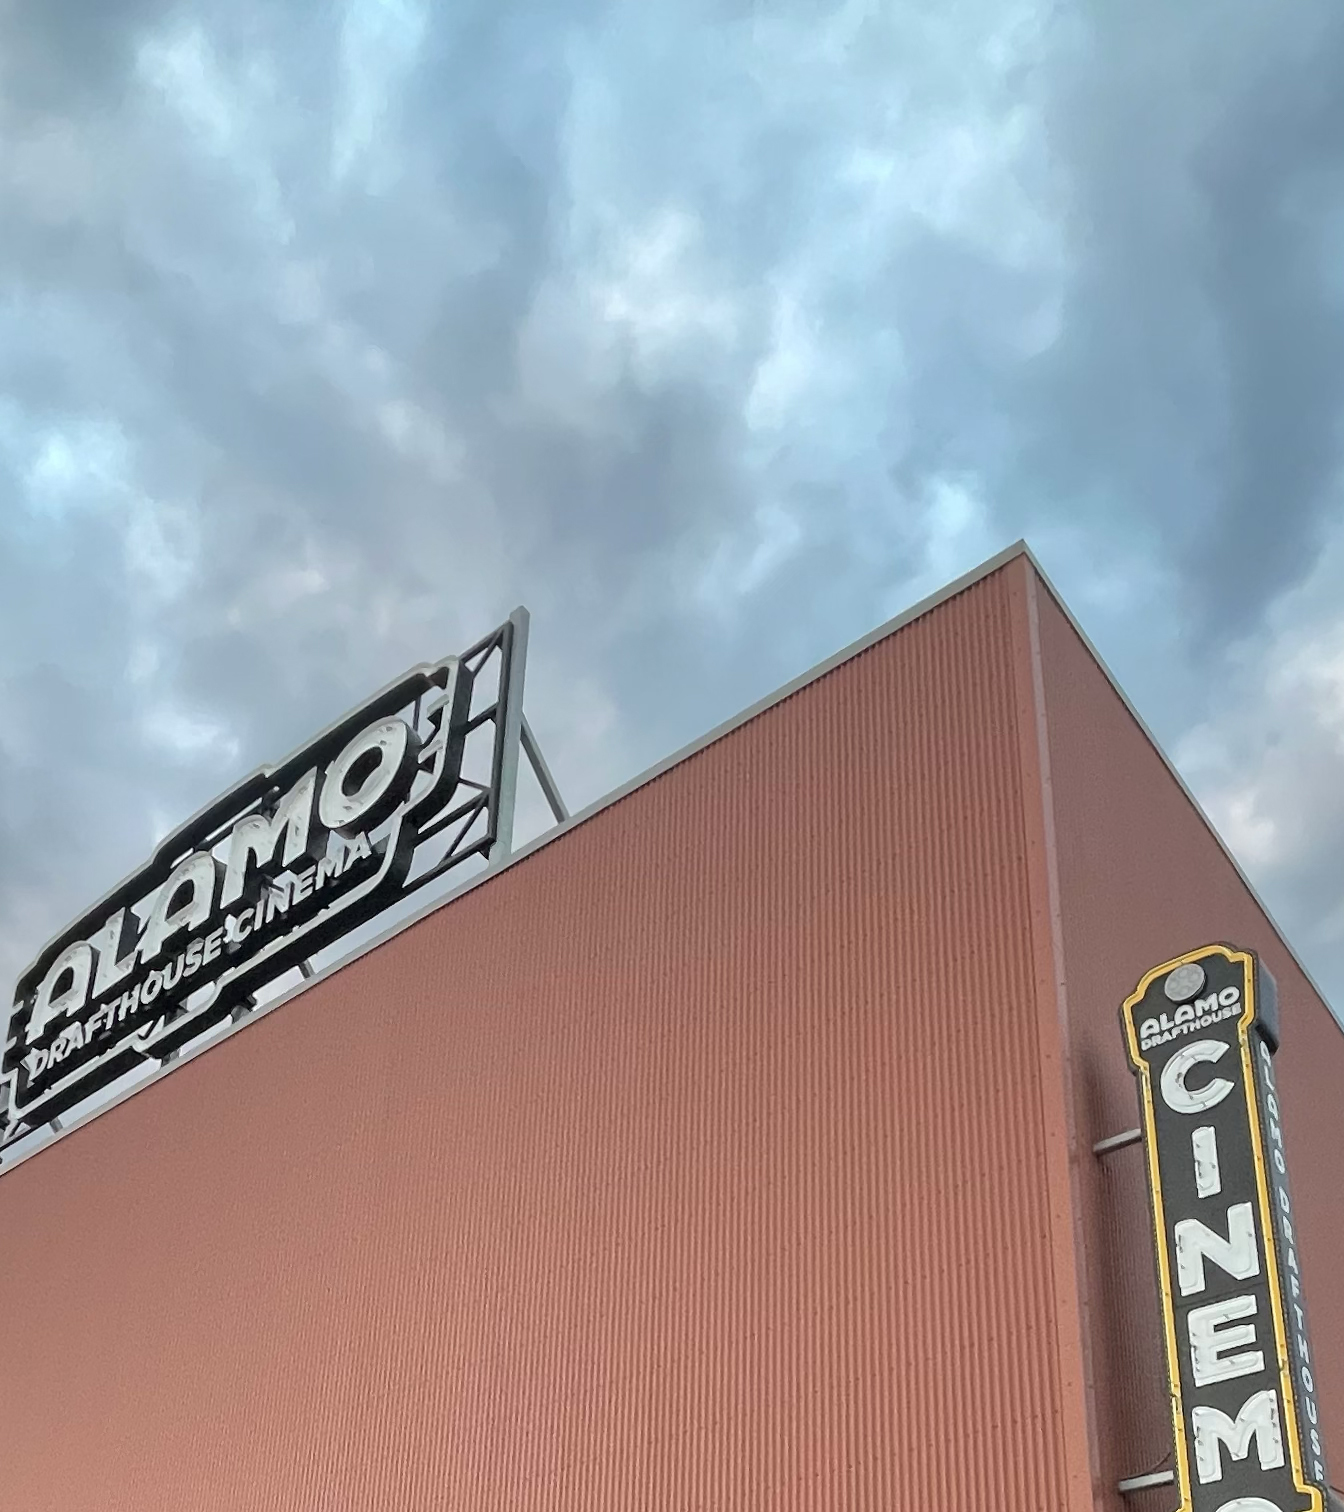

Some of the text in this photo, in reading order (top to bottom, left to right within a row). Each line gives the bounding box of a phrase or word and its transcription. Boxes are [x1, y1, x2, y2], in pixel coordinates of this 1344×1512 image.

[25, 716, 408, 1046] ALAMO
[26, 831, 373, 1083] DRAFTHOUSE CINEMA
[1140, 986, 1240, 1038] ALAMO
[1141, 1002, 1242, 1051] DRAFTHOUSE
[1279, 1186, 1324, 1481] DRAFTHOUSE
